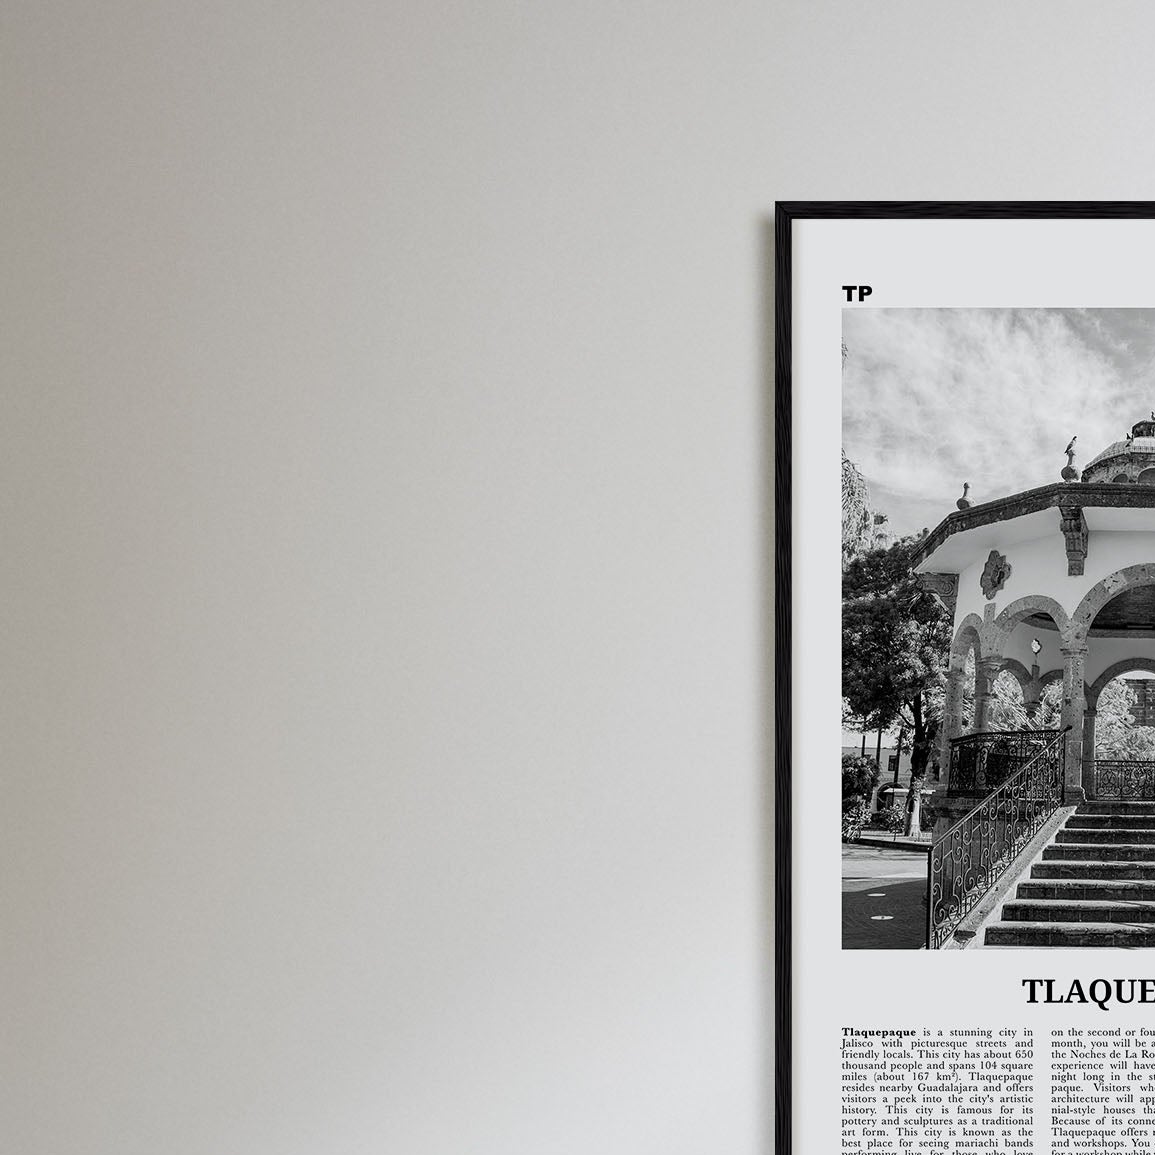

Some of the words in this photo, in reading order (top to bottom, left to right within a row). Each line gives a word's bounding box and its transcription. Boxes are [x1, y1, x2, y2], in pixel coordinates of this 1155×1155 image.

[841, 286, 873, 302] TP
[840, 1028, 917, 1039] Tlaquepaque
[923, 1028, 931, 1037] is
[949, 1028, 993, 1039] stunning
[998, 1028, 1018, 1039] city
[1023, 1028, 1033, 1037] in
[1068, 1028, 1084, 1037] the
[1087, 1028, 1121, 1037] second
[839, 1039, 874, 1050] Jalisco
[881, 1039, 903, 1048] with
[911, 1039, 968, 1050] picturesque
[975, 1039, 1007, 1048] streets
[1014, 1039, 1034, 1048] and
[841, 1050, 880, 1061] friendly
[883, 1050, 914, 1059] locals.
[916, 1050, 940, 1059] This
[942, 1050, 961, 1061] city
[964, 1050, 981, 1059] has
[983, 1050, 1012, 1059] about
[1015, 1050, 1034, 1059] 650
[1051, 1050, 1067, 1059] the
[1070, 1050, 1107, 1059] Noches
[1109, 1050, 1122, 1059] de
[1125, 1050, 1138, 1059] La
[841, 1072, 868, 1081] miles
[873, 1072, 905, 1083] (about
[913, 1072, 930, 1081] 167
[969, 1072, 1034, 1083] Tlaquepaque
[1051, 1072, 1077, 1083] night
[1083, 1072, 1105, 1083] long
[1110, 1072, 1121, 1081] in
[1127, 1072, 1143, 1081] the
[1051, 1085, 1084, 1094] paque.
[1094, 1083, 1131, 1092] Visitors
[841, 1094, 877, 1103] visitors
[894, 1094, 917, 1105] peek
[922, 1094, 943, 1103] into
[948, 1094, 964, 1103] the
[969, 1094, 994, 1105] city's
[999, 1094, 1034, 1103] artistic
[1051, 1094, 1110, 1103] architecture
[1116, 1094, 1134, 1103] will
[841, 1116, 878, 1127] pottery
[881, 1116, 900, 1125] and
[903, 1116, 954, 1127] sculptures
[981, 1116, 1033, 1125] traditional
[1051, 1116, 1091, 1125] Because
[1095, 1116, 1106, 1125] of
[1111, 1116, 1123, 1125] its
[841, 1139, 861, 1148] best
[867, 1139, 893, 1150] place
[899, 1139, 914, 1148] for
[918, 1139, 950, 1150] seeing
[955, 1139, 999, 1148] mariachi
[1004, 1139, 1034, 1148] bands
[1051, 1139, 1070, 1148] and
[1073, 1139, 1127, 1150] workshops.
[1132, 1139, 1151, 1148] You
